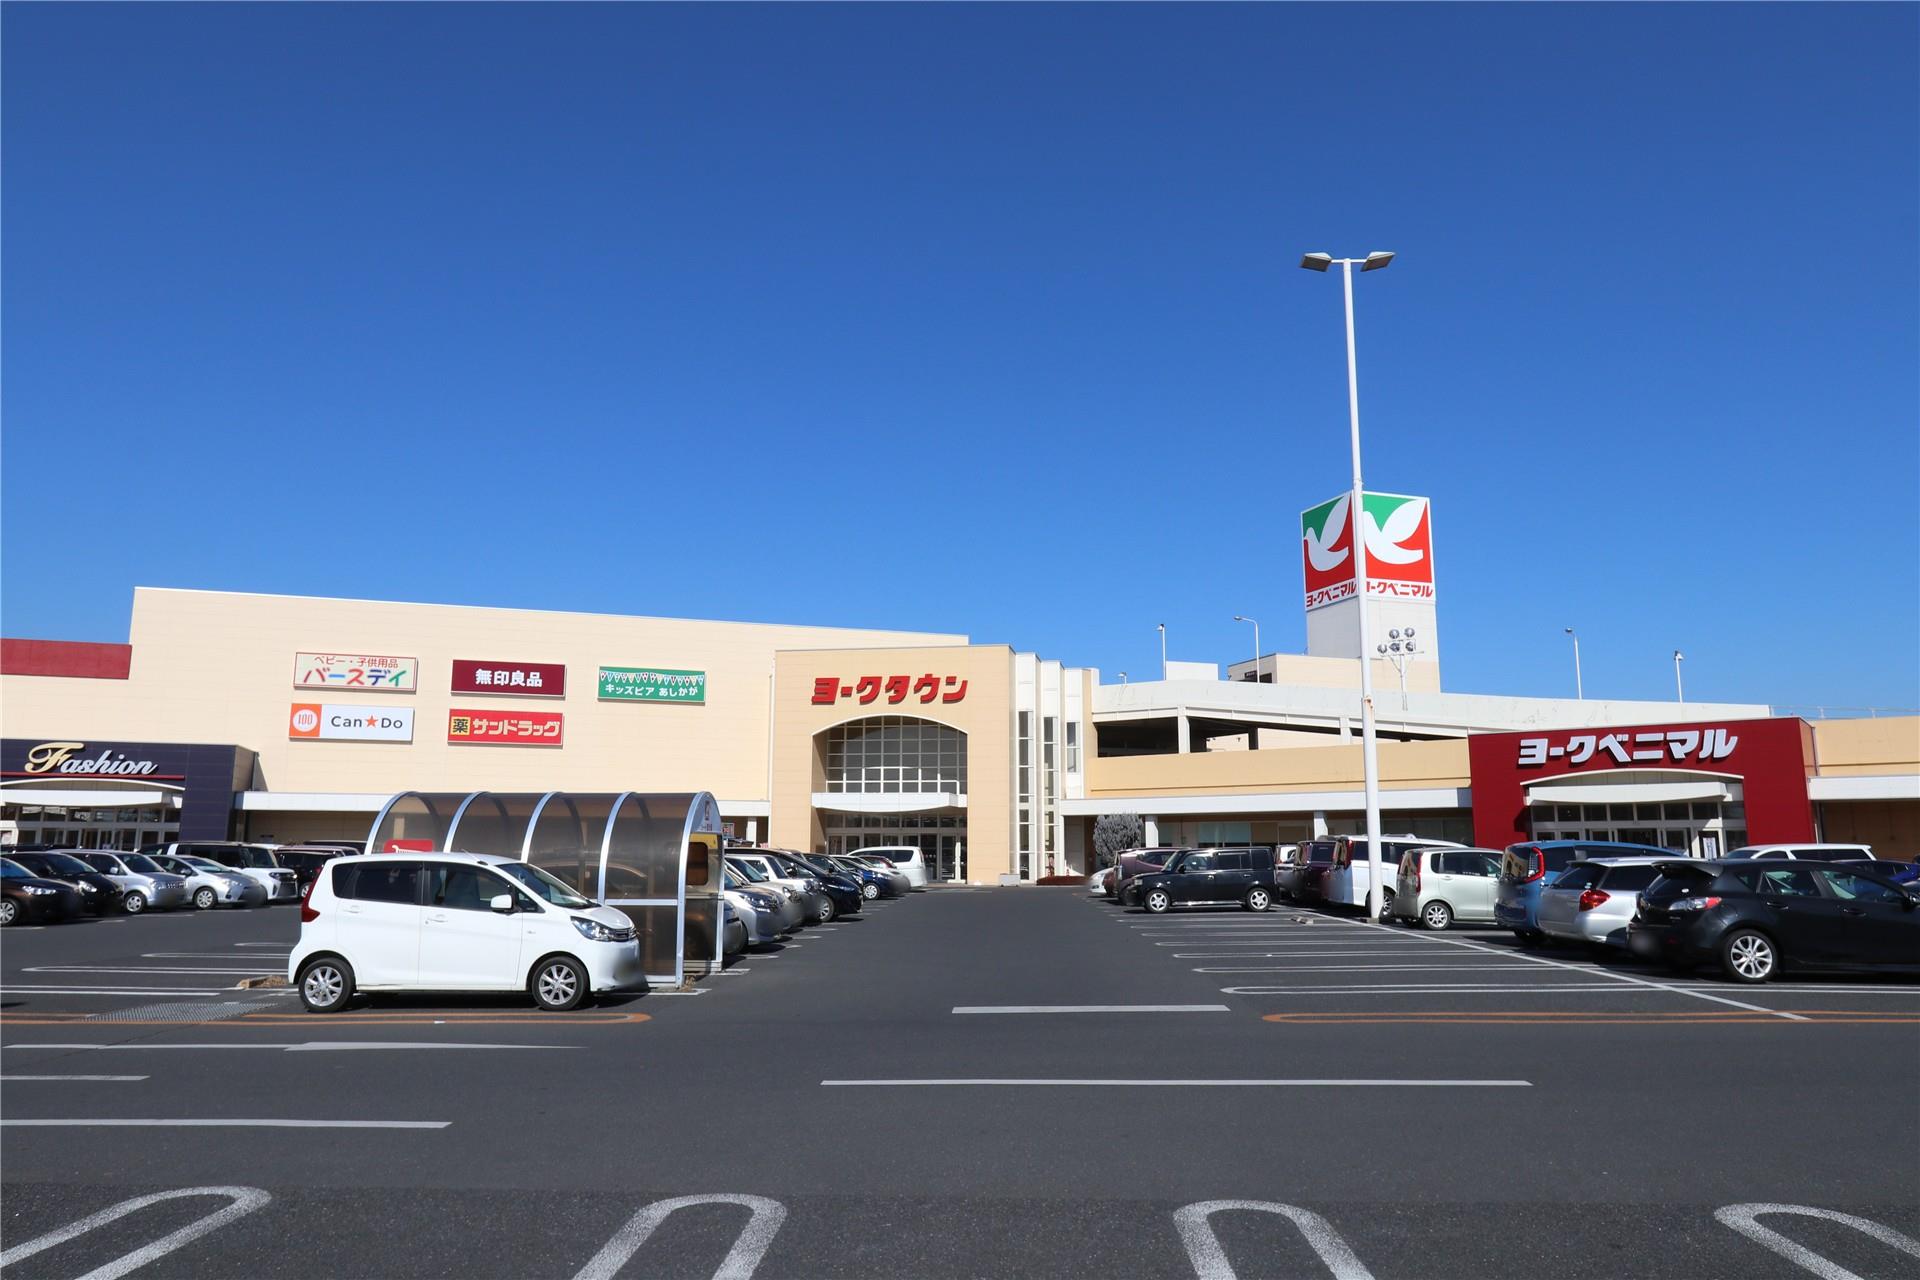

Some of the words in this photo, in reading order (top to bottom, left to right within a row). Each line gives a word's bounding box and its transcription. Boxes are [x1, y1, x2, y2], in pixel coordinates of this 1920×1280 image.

[1306, 581, 1357, 608] ヨークベニマル
[475, 668, 543, 687] 無印良品
[811, 674, 968, 705] ヨークタウン
[24, 742, 157, 775] Fashion
[1518, 729, 1738, 766] ヨークベニマル
